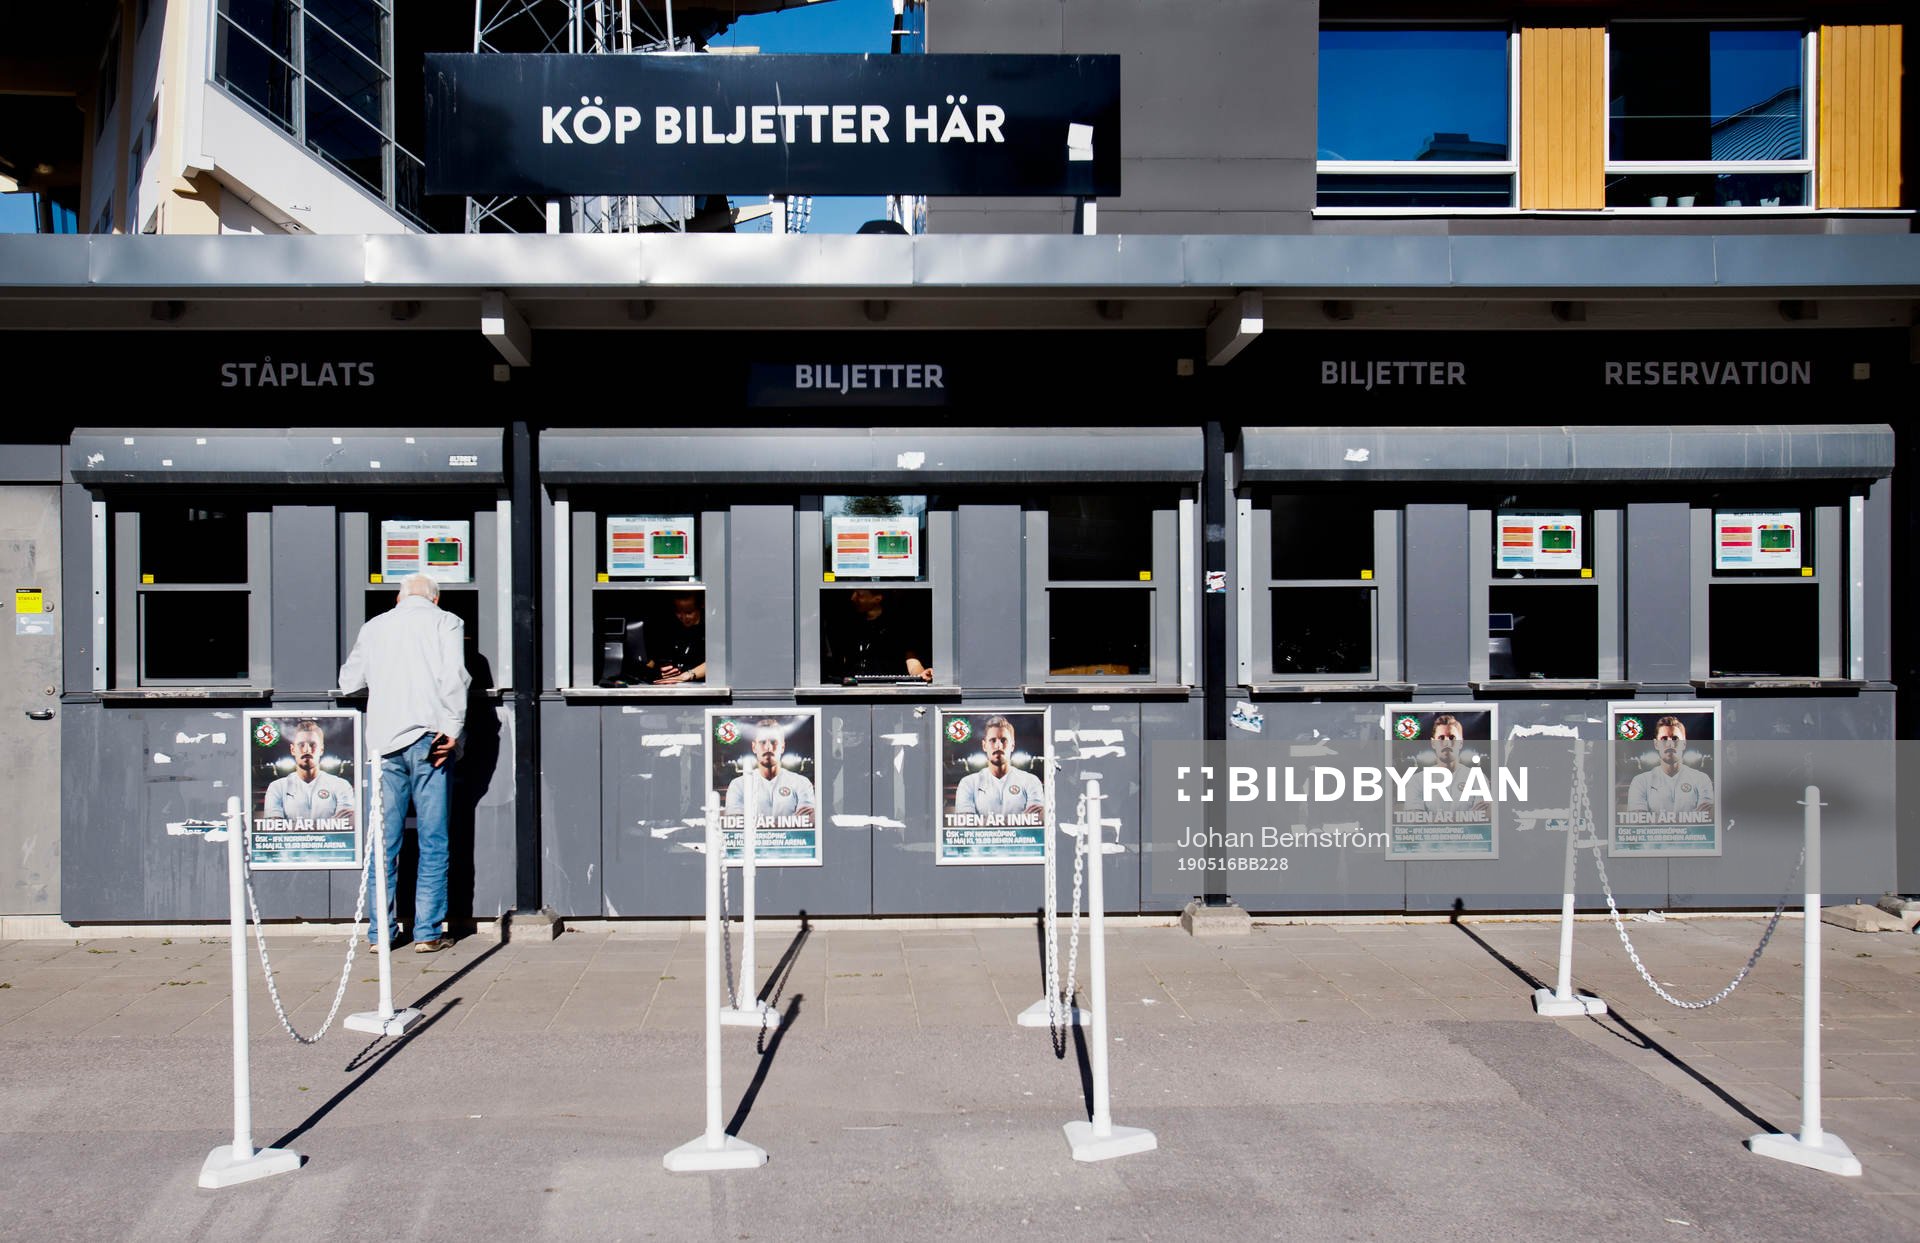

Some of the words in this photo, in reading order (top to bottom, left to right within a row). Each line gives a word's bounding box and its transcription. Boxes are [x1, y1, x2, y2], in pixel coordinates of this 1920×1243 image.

[543, 95, 642, 145] KÖP
[655, 104, 890, 145] BILJETTER
[905, 94, 1006, 143] HÄR
[221, 356, 374, 387] STÅPLATS
[796, 365, 943, 395] BILJETTER
[1321, 361, 1466, 390] BILJETTER
[1605, 361, 1811, 385] RESERVATION
[254, 818, 292, 831] TIDEN
[294, 816, 315, 831] ÄR
[317, 818, 353, 830] INNE.
[757, 814, 775, 828] ÄR
[778, 815, 813, 828] INNE.
[945, 814, 984, 826] TIDEN
[986, 811, 1005, 826] ÄR
[1008, 813, 1042, 826] INNE.
[1394, 811, 1432, 823] TIDEN
[1434, 809, 1454, 823] ÄR
[1455, 810, 1489, 822] INNE.
[1617, 812, 1655, 823] TIDEN
[1657, 809, 1676, 823] ÄR
[1679, 811, 1712, 823] INNE.
